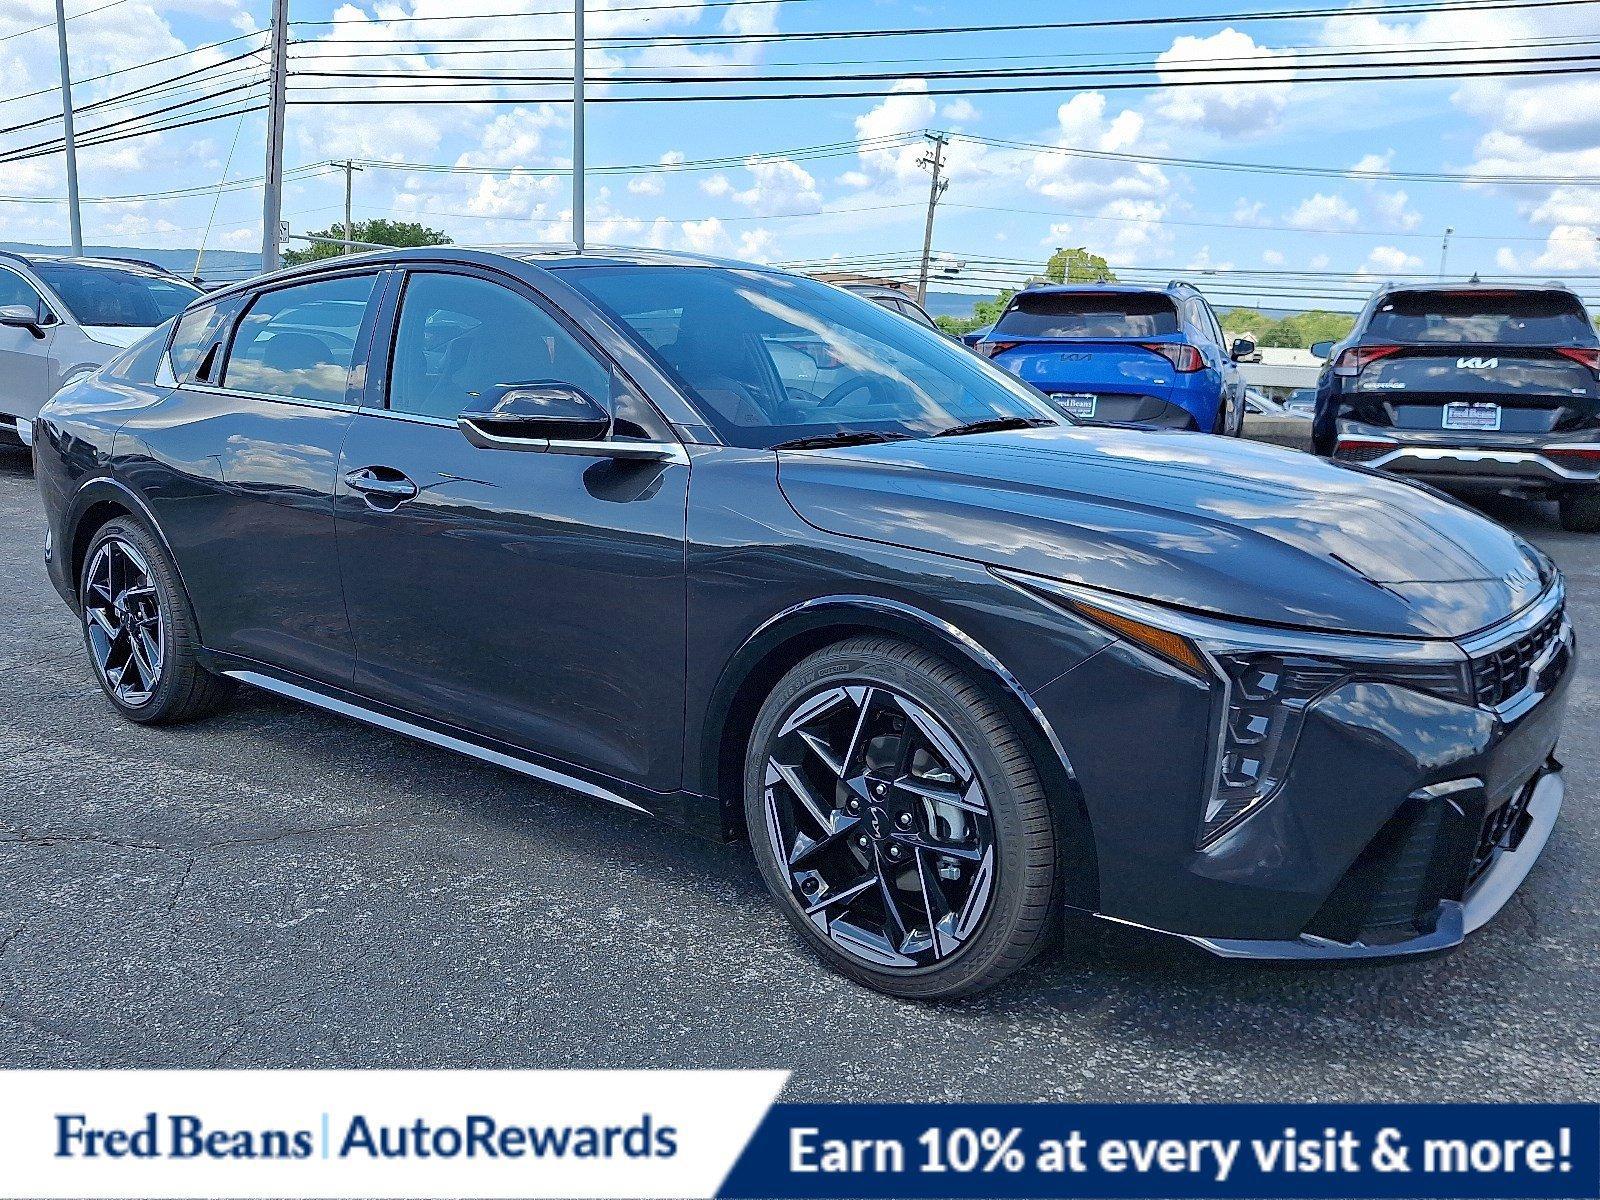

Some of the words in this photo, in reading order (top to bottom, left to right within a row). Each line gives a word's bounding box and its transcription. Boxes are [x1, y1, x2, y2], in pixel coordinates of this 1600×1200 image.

[1061, 353, 1093, 361] KIA
[1457, 357, 1498, 369] KIA
[1070, 399, 1092, 407] Beans
[820, 665, 848, 675] OUTSIDE
